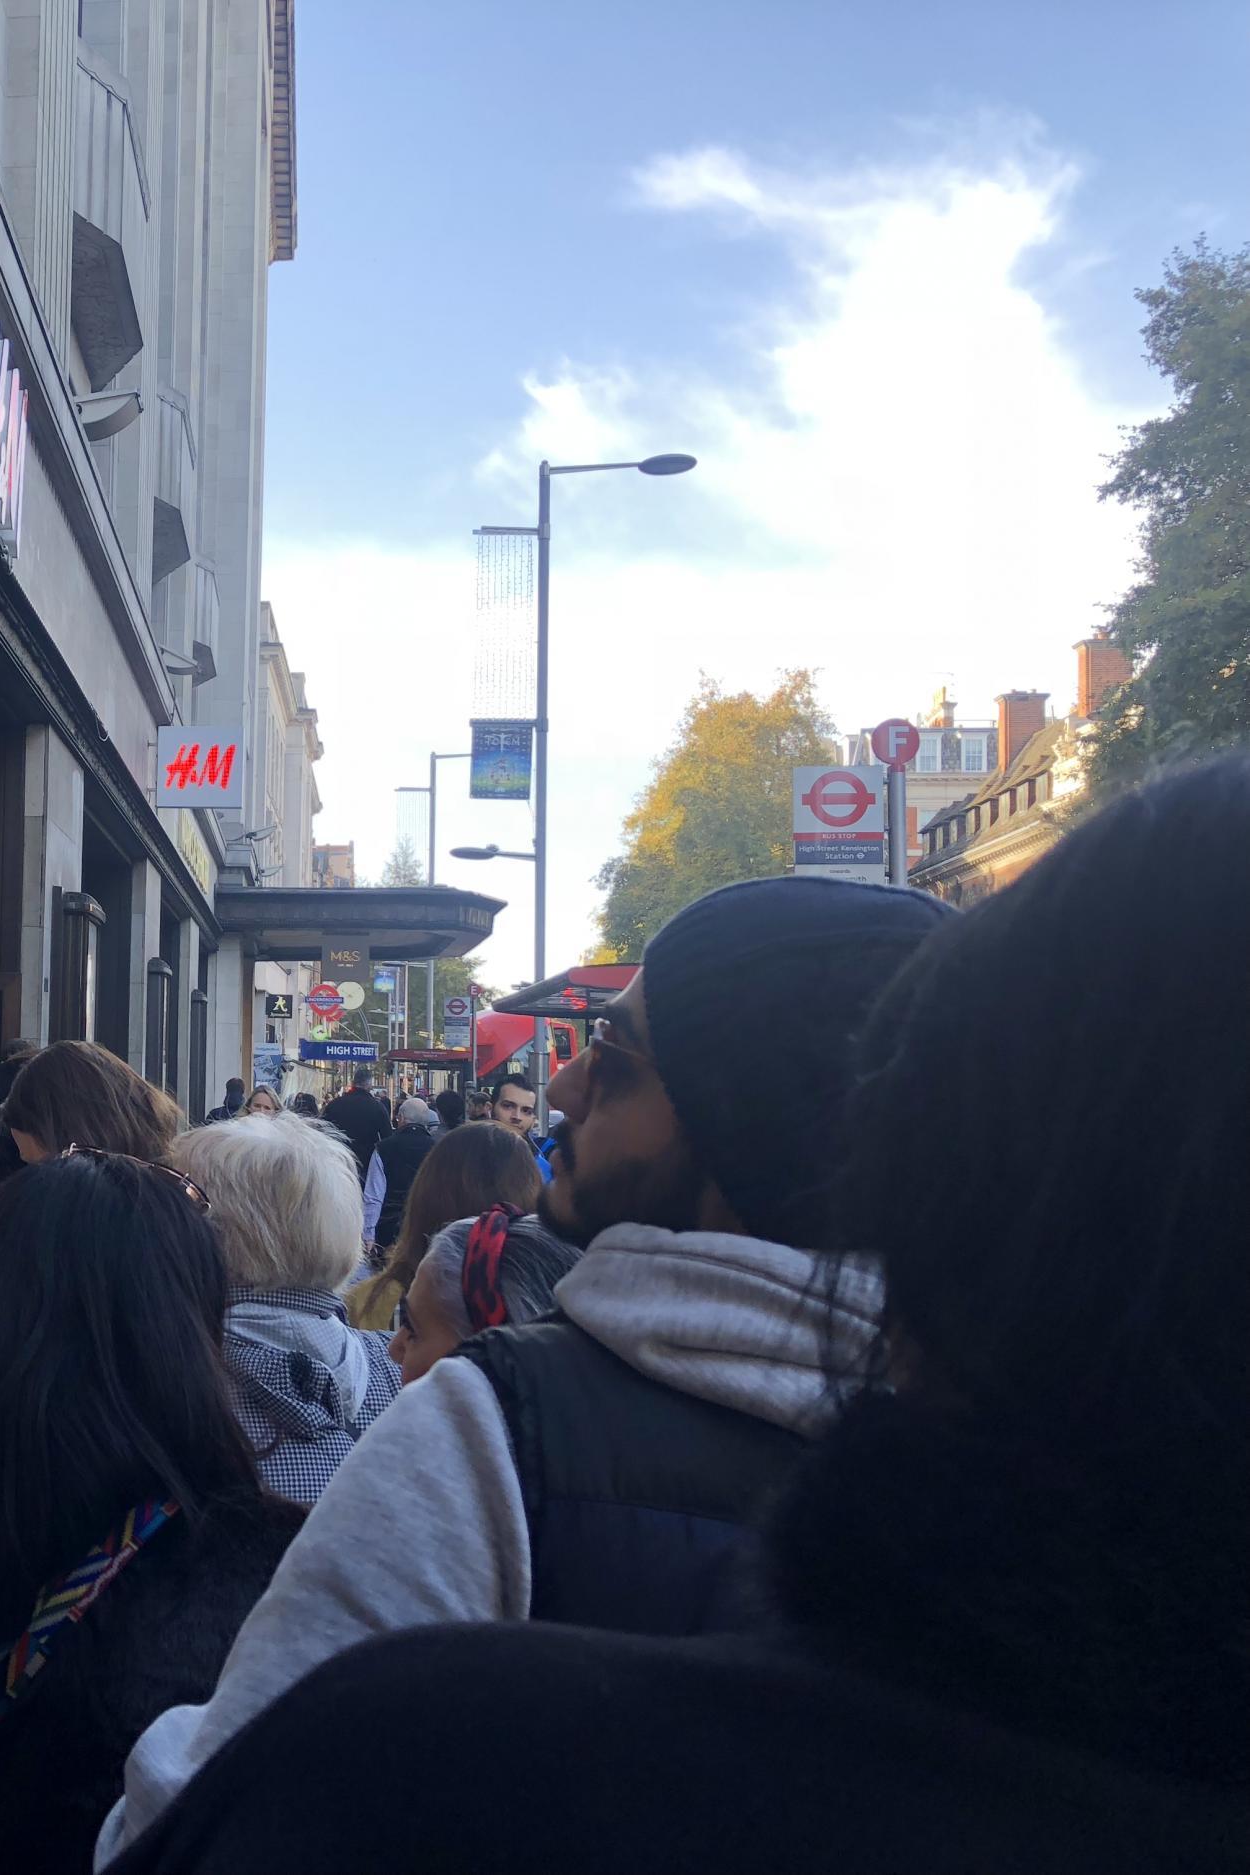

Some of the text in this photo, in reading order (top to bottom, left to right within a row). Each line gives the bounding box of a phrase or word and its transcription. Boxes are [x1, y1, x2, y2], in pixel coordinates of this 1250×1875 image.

[889, 726, 909, 757] F
[165, 744, 236, 790] H&M
[825, 852, 855, 860] Station
[331, 950, 360, 961] M&S
[472, 986, 477, 995] E
[326, 1045, 375, 1057] HIGH STREET
